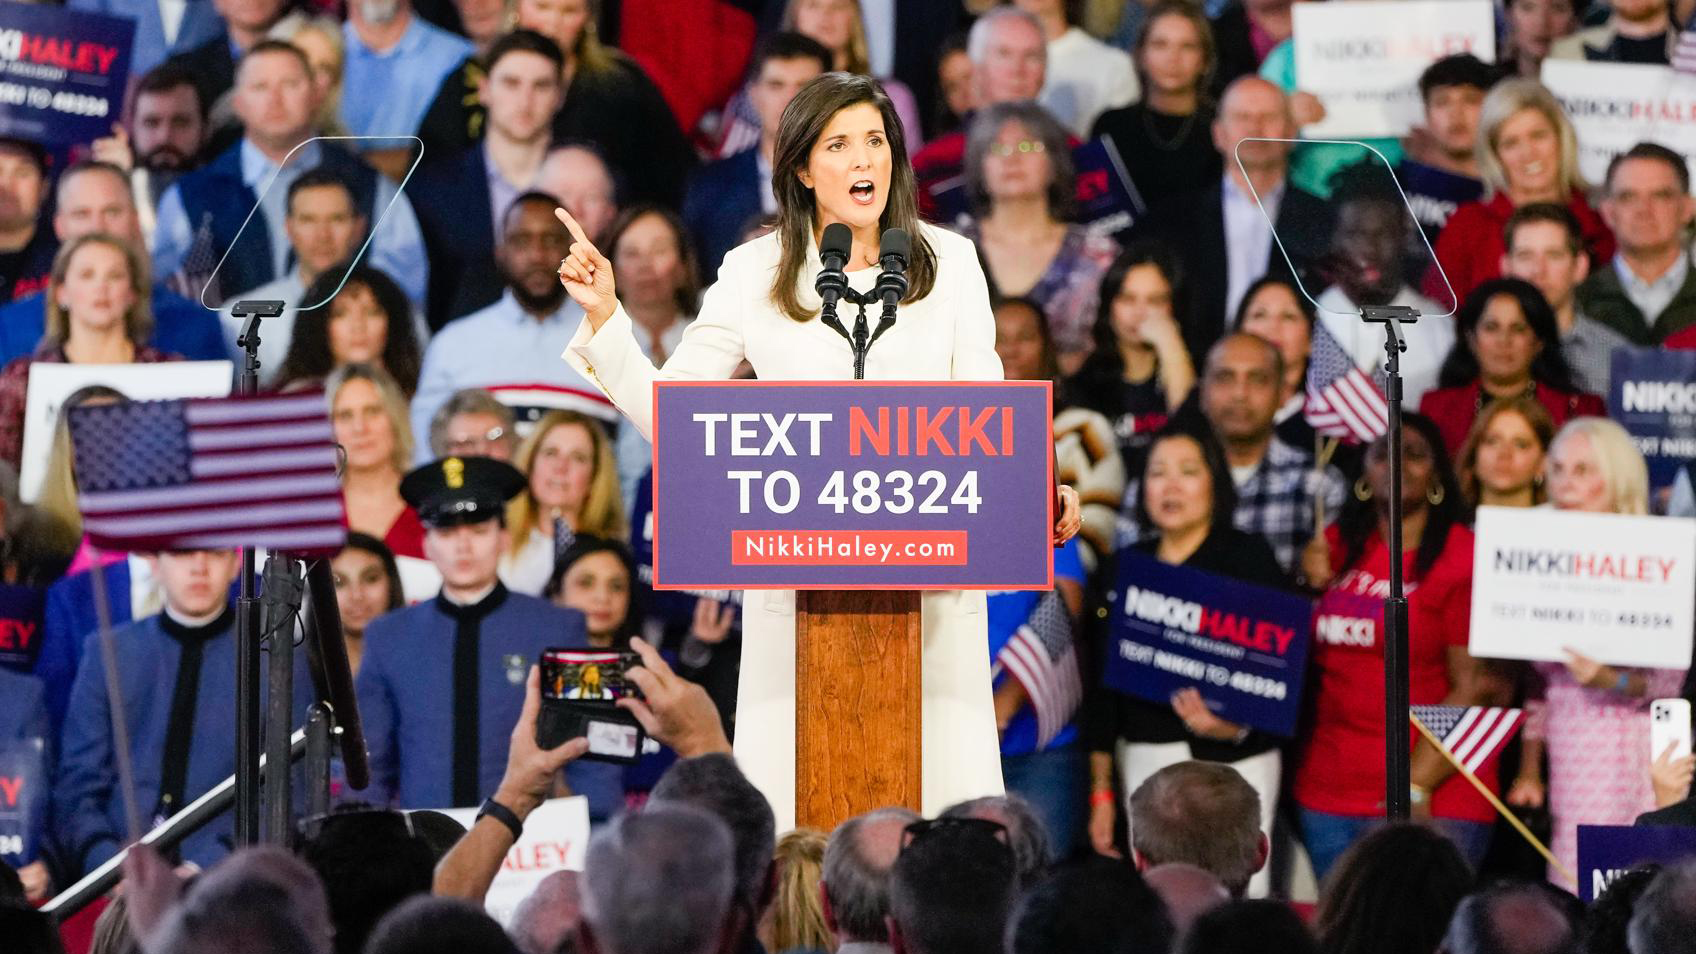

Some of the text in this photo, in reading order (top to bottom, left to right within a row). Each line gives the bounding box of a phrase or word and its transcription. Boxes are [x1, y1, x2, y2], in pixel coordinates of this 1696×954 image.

[693, 406, 1014, 456] TEXT NIKKI
[727, 470, 983, 514] TO 48324
[745, 535, 956, 562] NikkiHaley.com
[1205, 663, 1231, 687] TO
